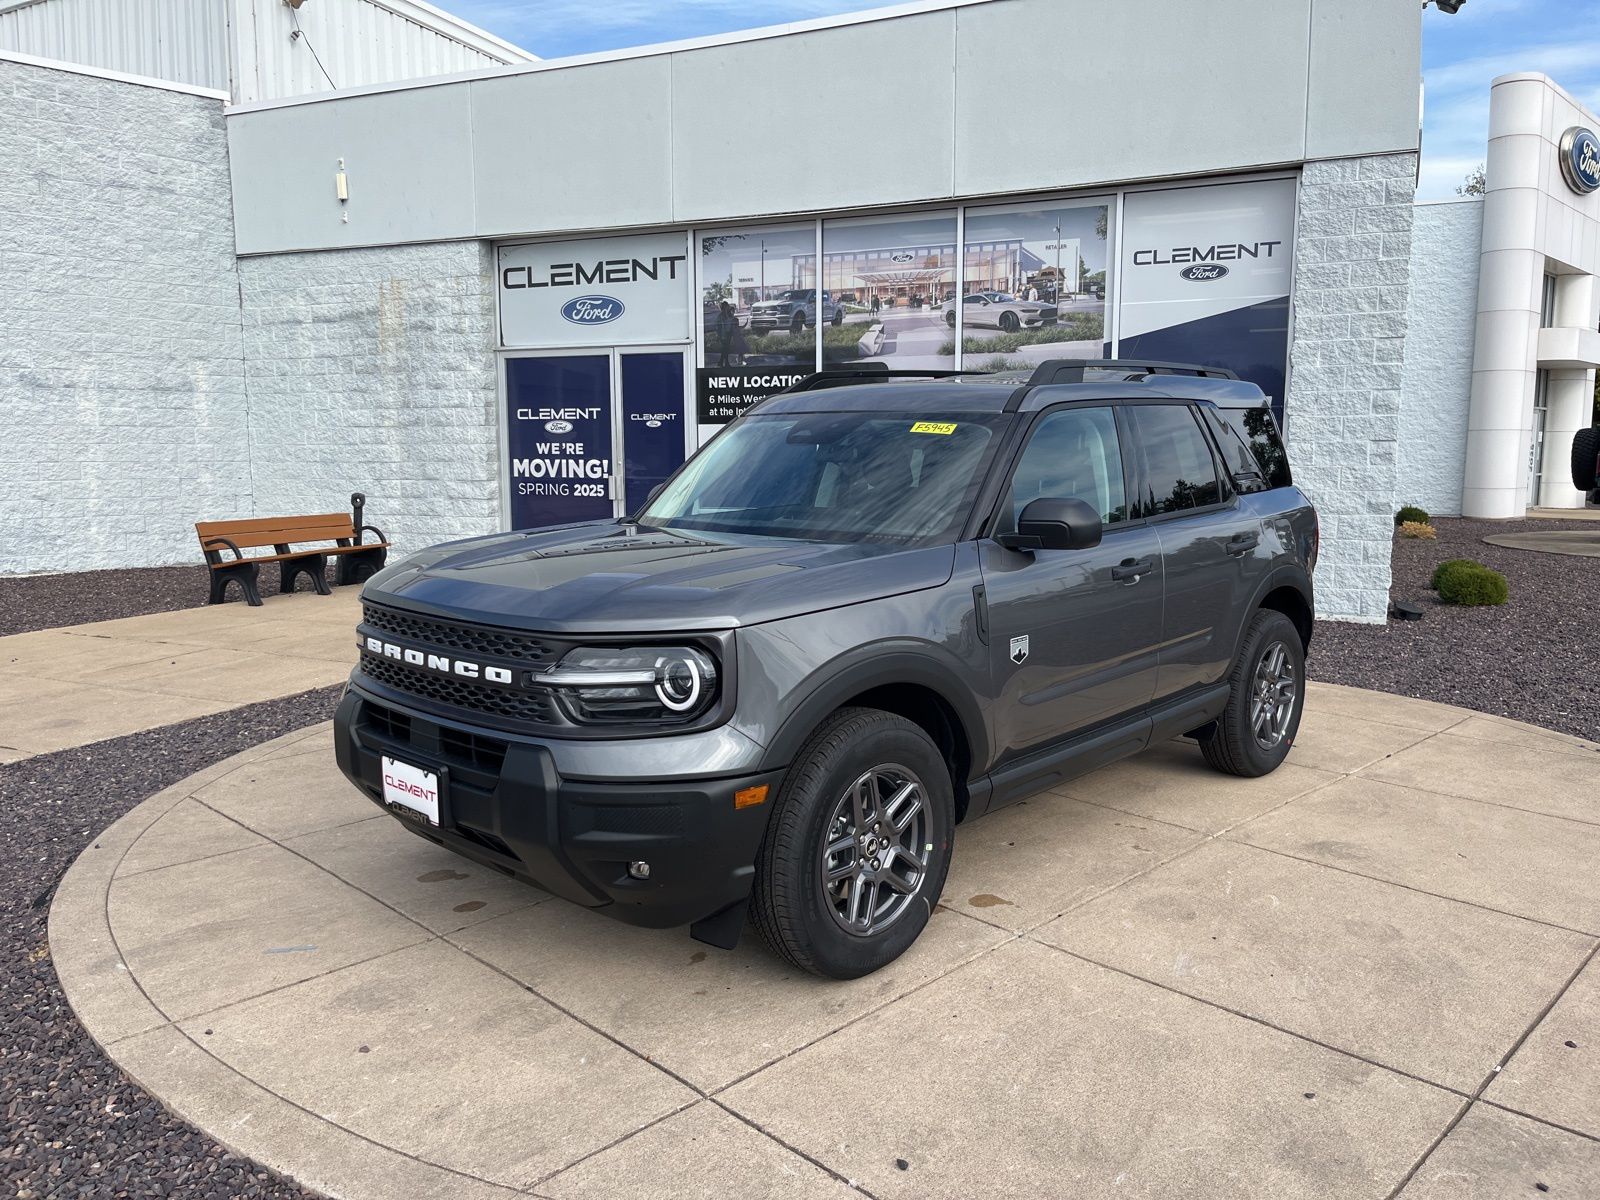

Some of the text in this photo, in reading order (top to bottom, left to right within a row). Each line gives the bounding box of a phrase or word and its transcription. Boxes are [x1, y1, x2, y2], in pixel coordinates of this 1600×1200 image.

[1133, 241, 1281, 266] CLEMENT
[503, 255, 686, 289] CLEMENT
[1189, 266, 1218, 279] Ford
[572, 299, 613, 320] Ford
[708, 375, 806, 388] NEW LOCATIO
[709, 395, 715, 403] 6
[717, 394, 741, 404] Miles
[517, 408, 601, 420] CLEMENT
[630, 413, 676, 421] CLEMENT
[709, 407, 717, 416] at
[719, 407, 733, 416] the
[550, 422, 568, 431] Ford
[915, 423, 953, 433] F5945
[536, 443, 584, 455] WE'RE
[513, 458, 609, 479] MOVING!
[518, 482, 604, 497] SPRING 2025
[367, 637, 512, 684] BRONCO
[385, 774, 436, 802] CLEMENT
